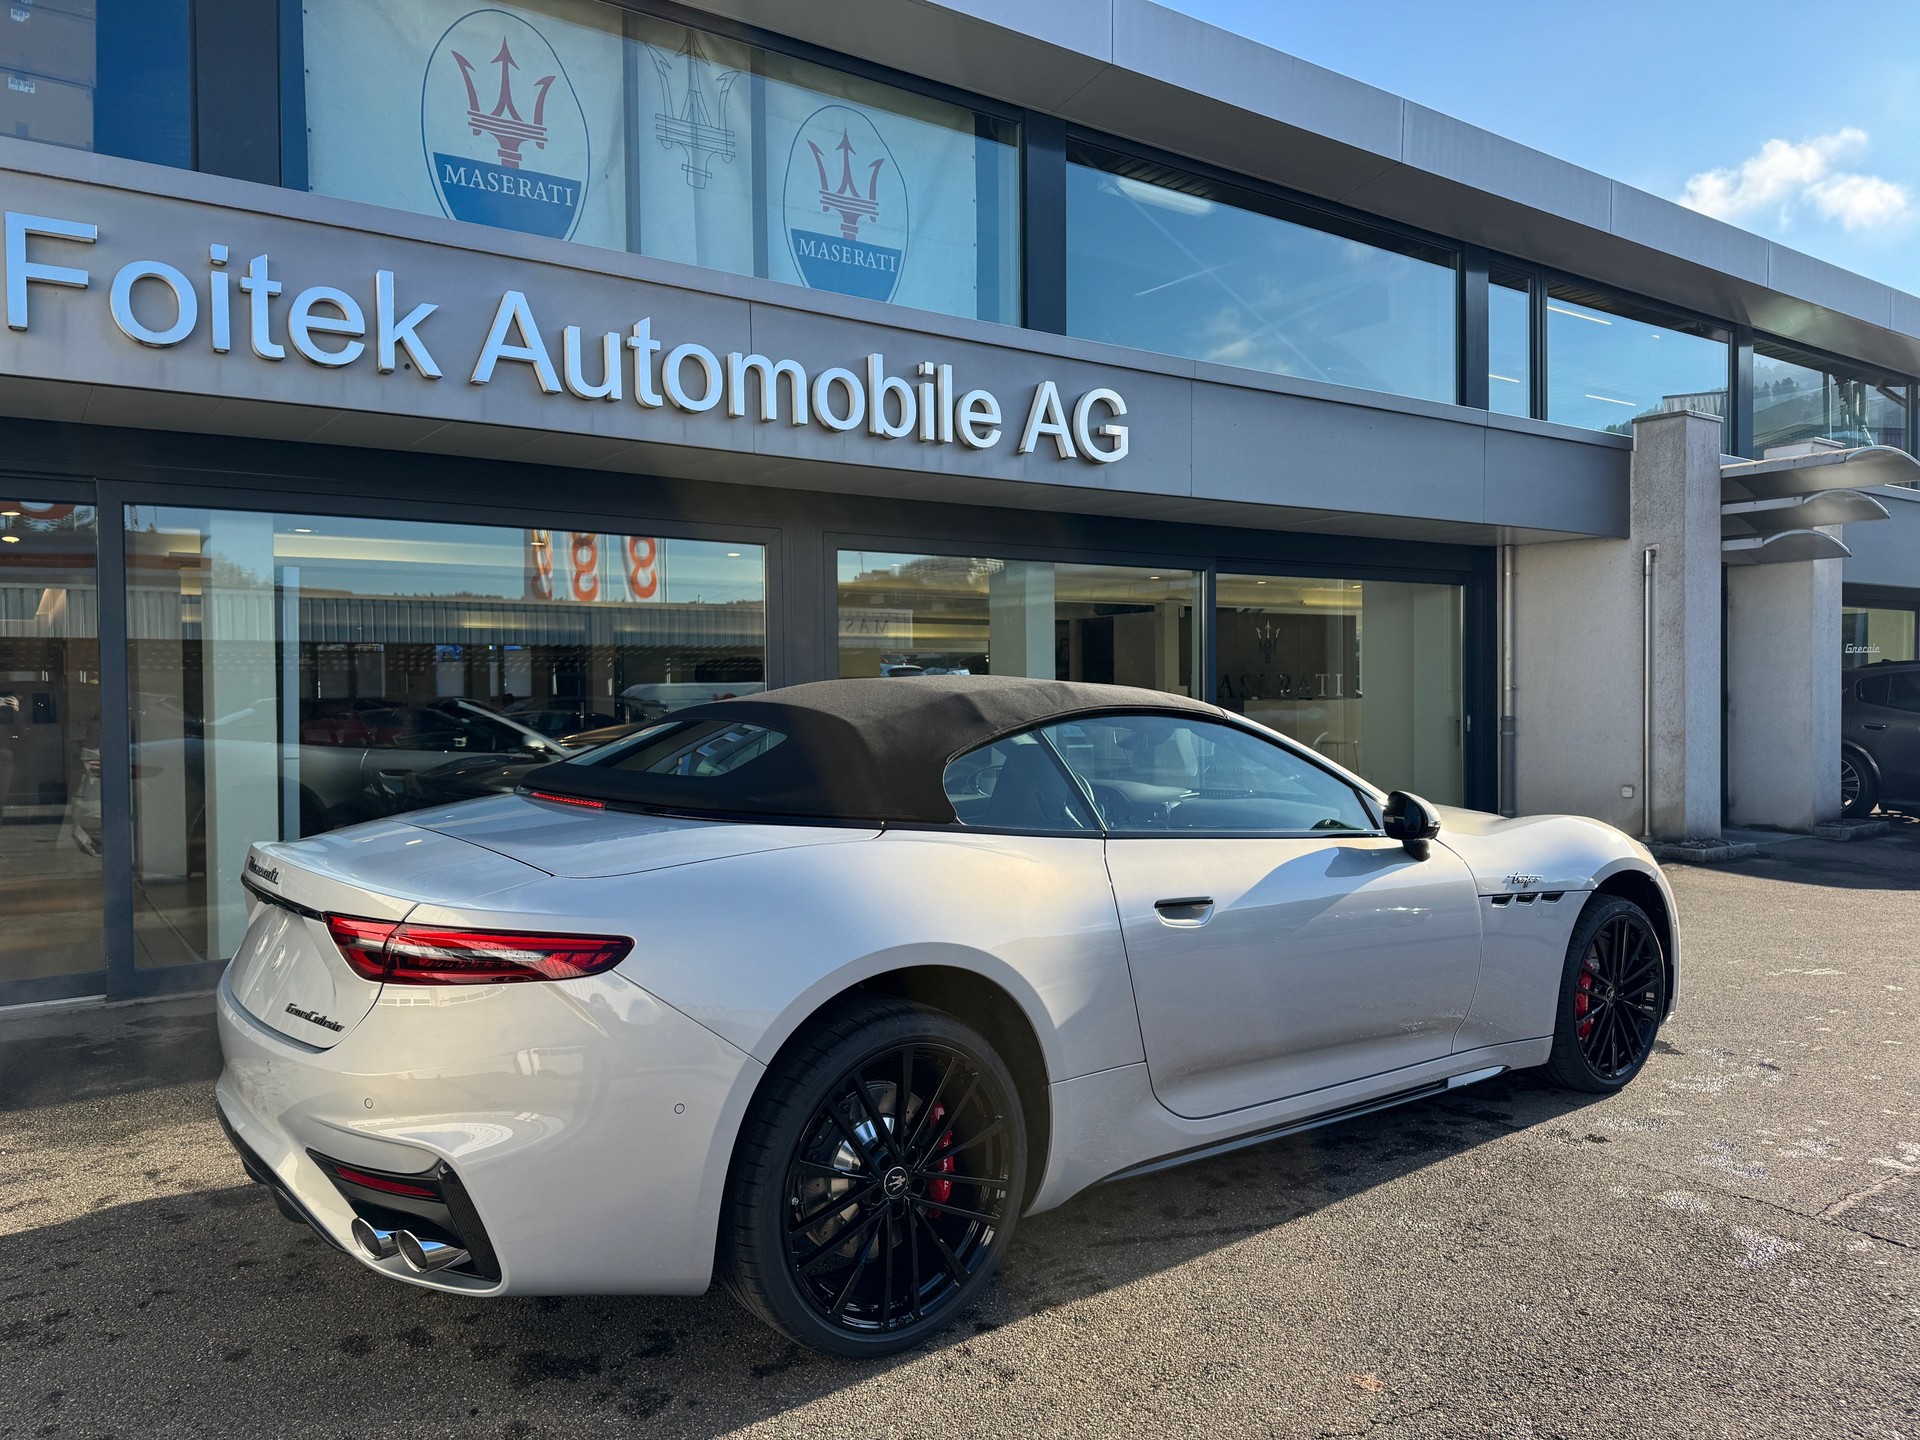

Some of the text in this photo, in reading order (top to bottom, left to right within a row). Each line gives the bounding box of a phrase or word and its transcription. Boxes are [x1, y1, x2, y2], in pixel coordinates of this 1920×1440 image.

[443, 163, 573, 207] MASERATI
[798, 238, 896, 273] MASERATI
[4, 211, 1130, 464] Foitek Automobile AG
[1217, 673, 1344, 699] ASERATI
